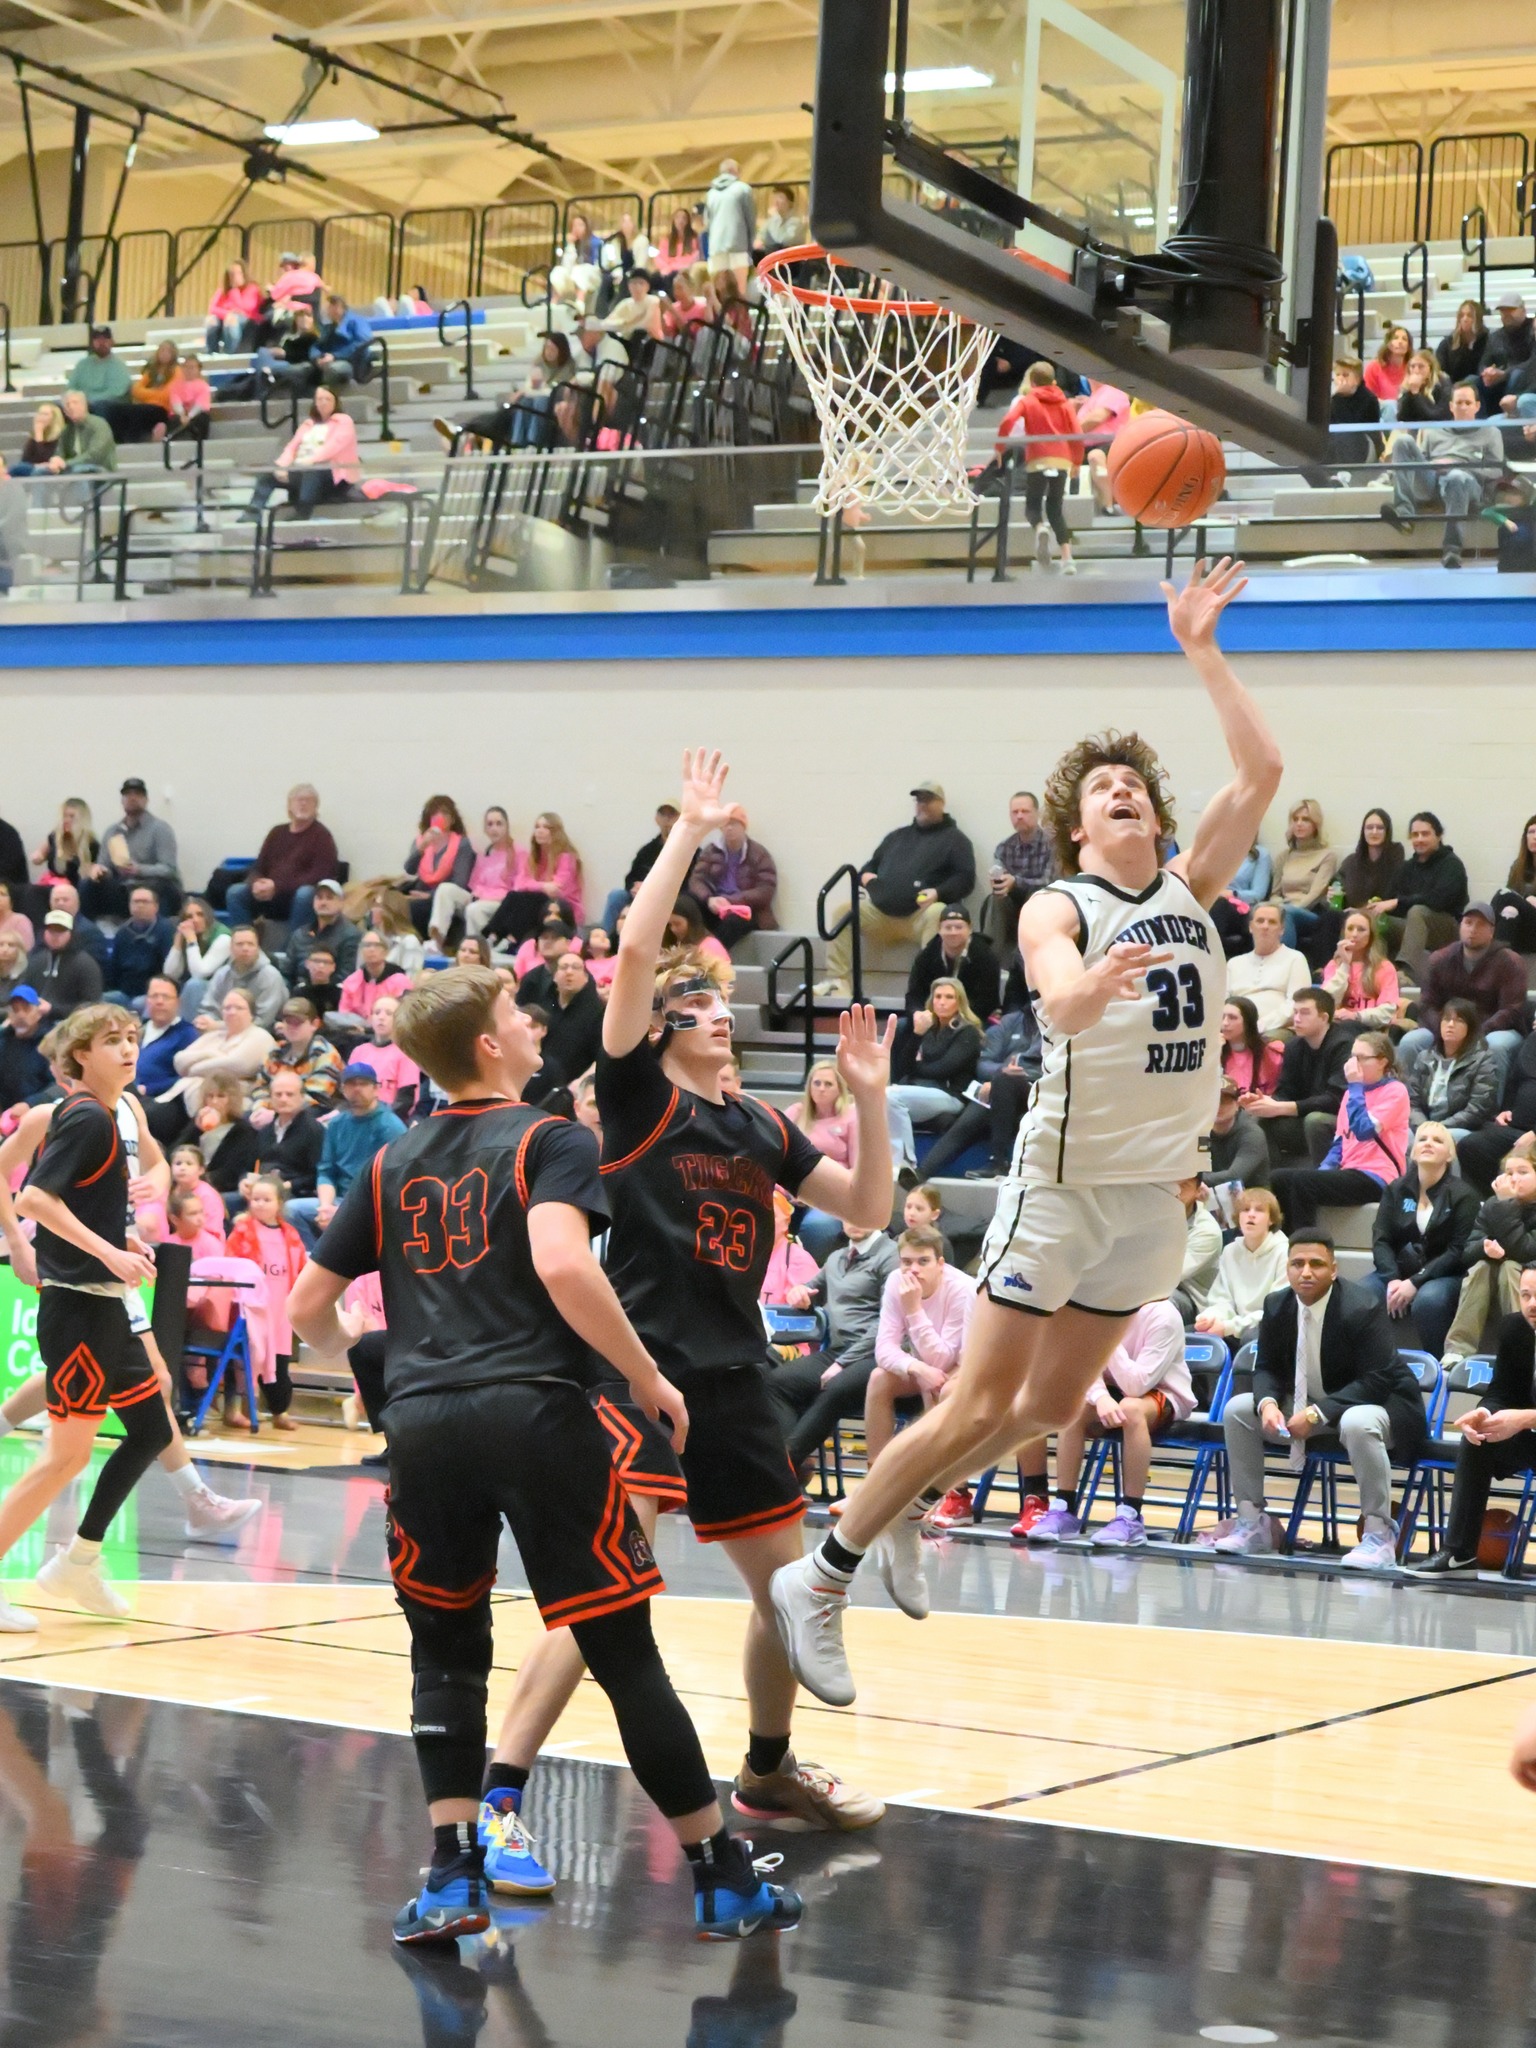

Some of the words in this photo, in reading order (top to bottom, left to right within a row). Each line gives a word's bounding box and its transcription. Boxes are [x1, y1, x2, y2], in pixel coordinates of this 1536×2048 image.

[1146, 963, 1205, 1032] 33
[400, 1167, 490, 1274] 33
[695, 1201, 756, 1272] 23
